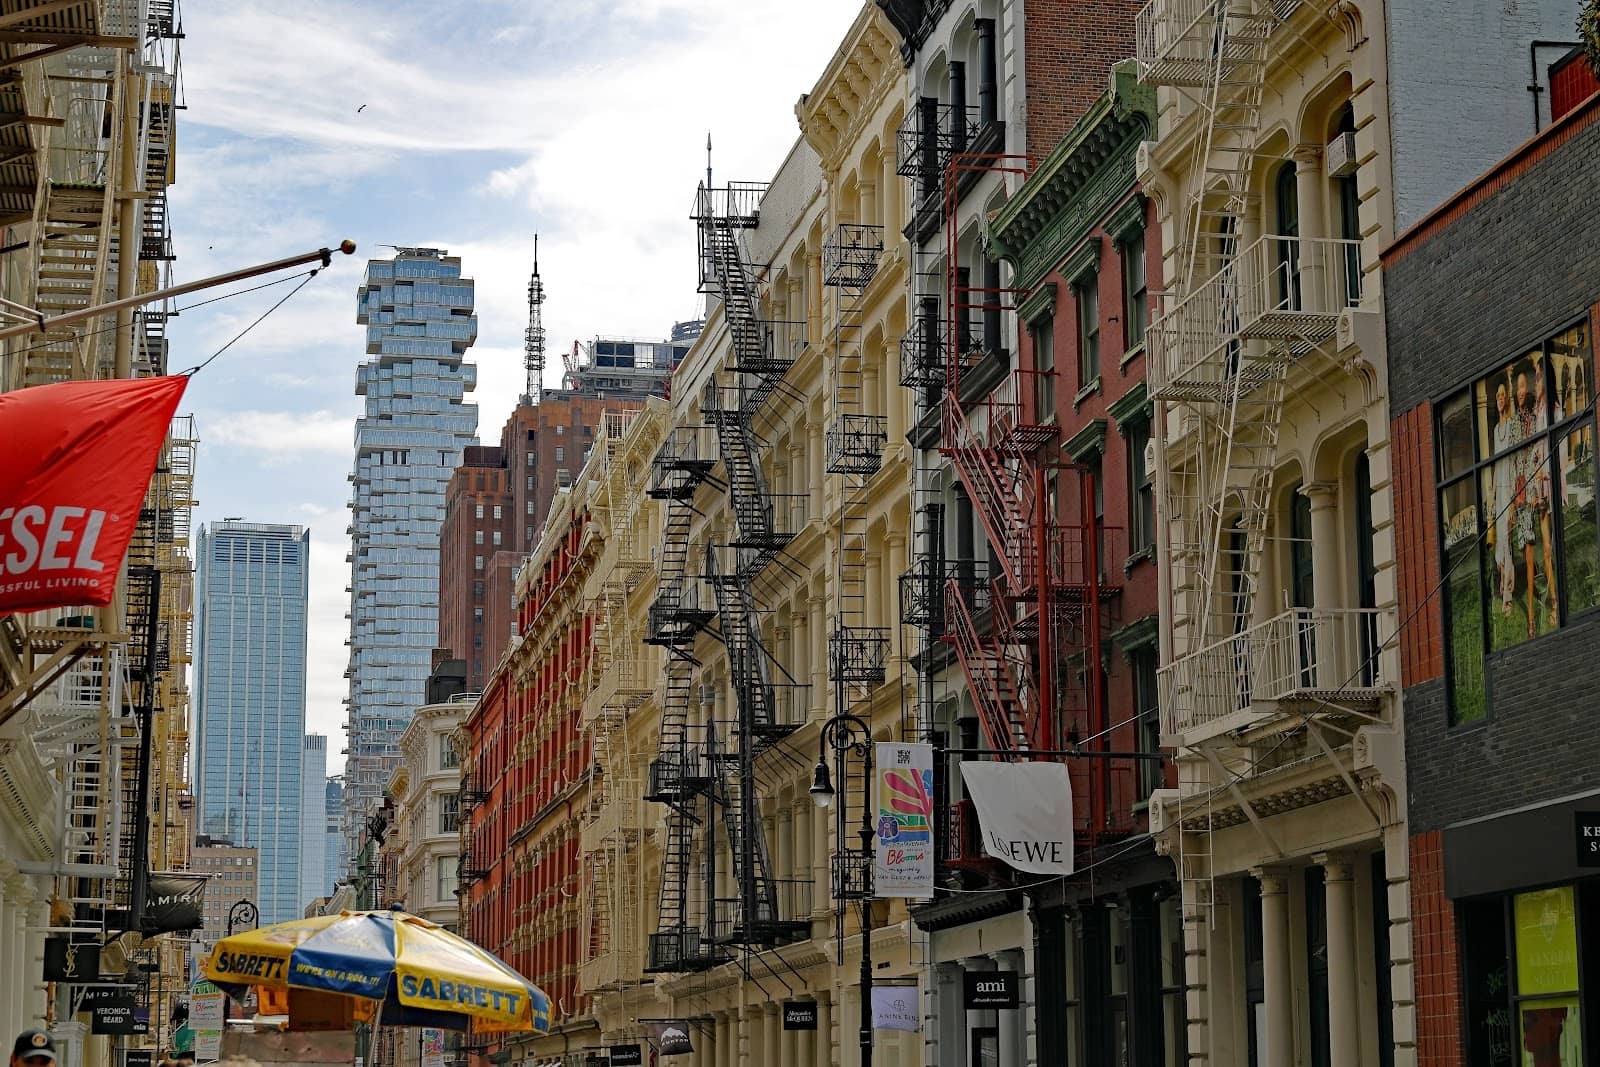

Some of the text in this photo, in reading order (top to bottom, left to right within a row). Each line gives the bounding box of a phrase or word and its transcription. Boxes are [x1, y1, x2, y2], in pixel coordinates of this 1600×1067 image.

[0, 505, 107, 575] SEL
[47, 578, 100, 589] LIVING
[990, 831, 1063, 863] LOEWE
[1590, 841, 1600, 852] S
[146, 894, 198, 908] AMIRI
[216, 950, 287, 980] SABRETT
[338, 971, 346, 981] A
[346, 972, 368, 984] ROLL
[976, 978, 1006, 992] ami
[402, 975, 521, 1015] SABRETT
[96, 1007, 130, 1015] VERONICA
[102, 1016, 124, 1024] BEARD
